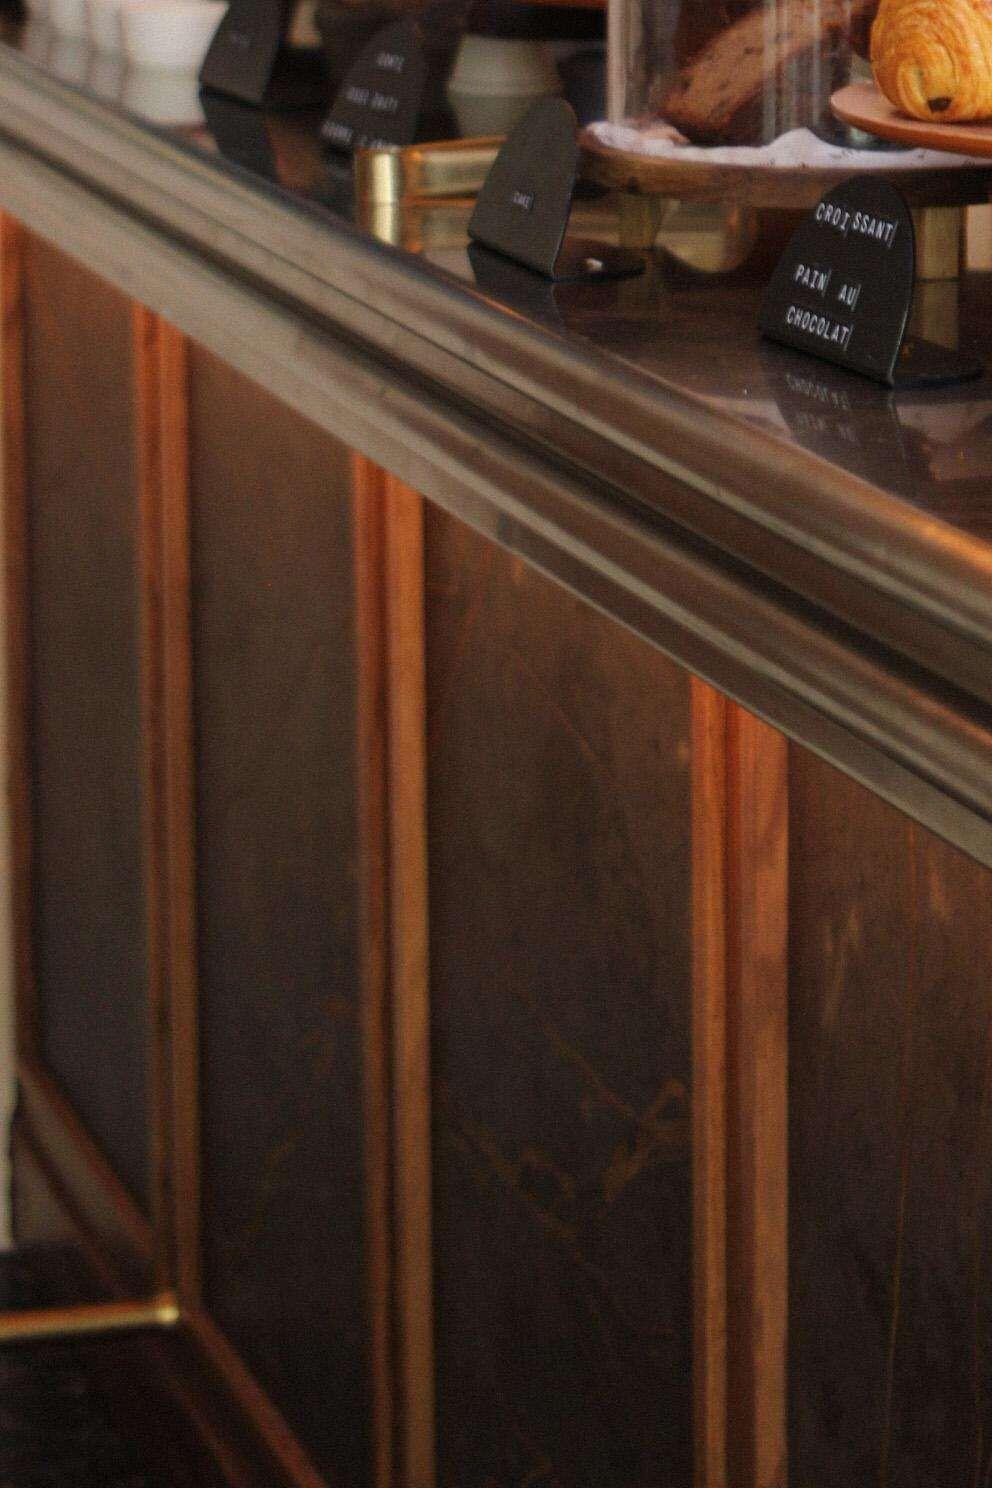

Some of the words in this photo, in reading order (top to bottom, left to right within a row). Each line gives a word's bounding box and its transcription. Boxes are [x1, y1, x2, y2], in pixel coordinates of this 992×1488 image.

[816, 202, 894, 242] CROISSANT
[795, 264, 828, 291] PAIN
[838, 284, 858, 306] AU
[787, 305, 850, 344] CHOCOLAT
